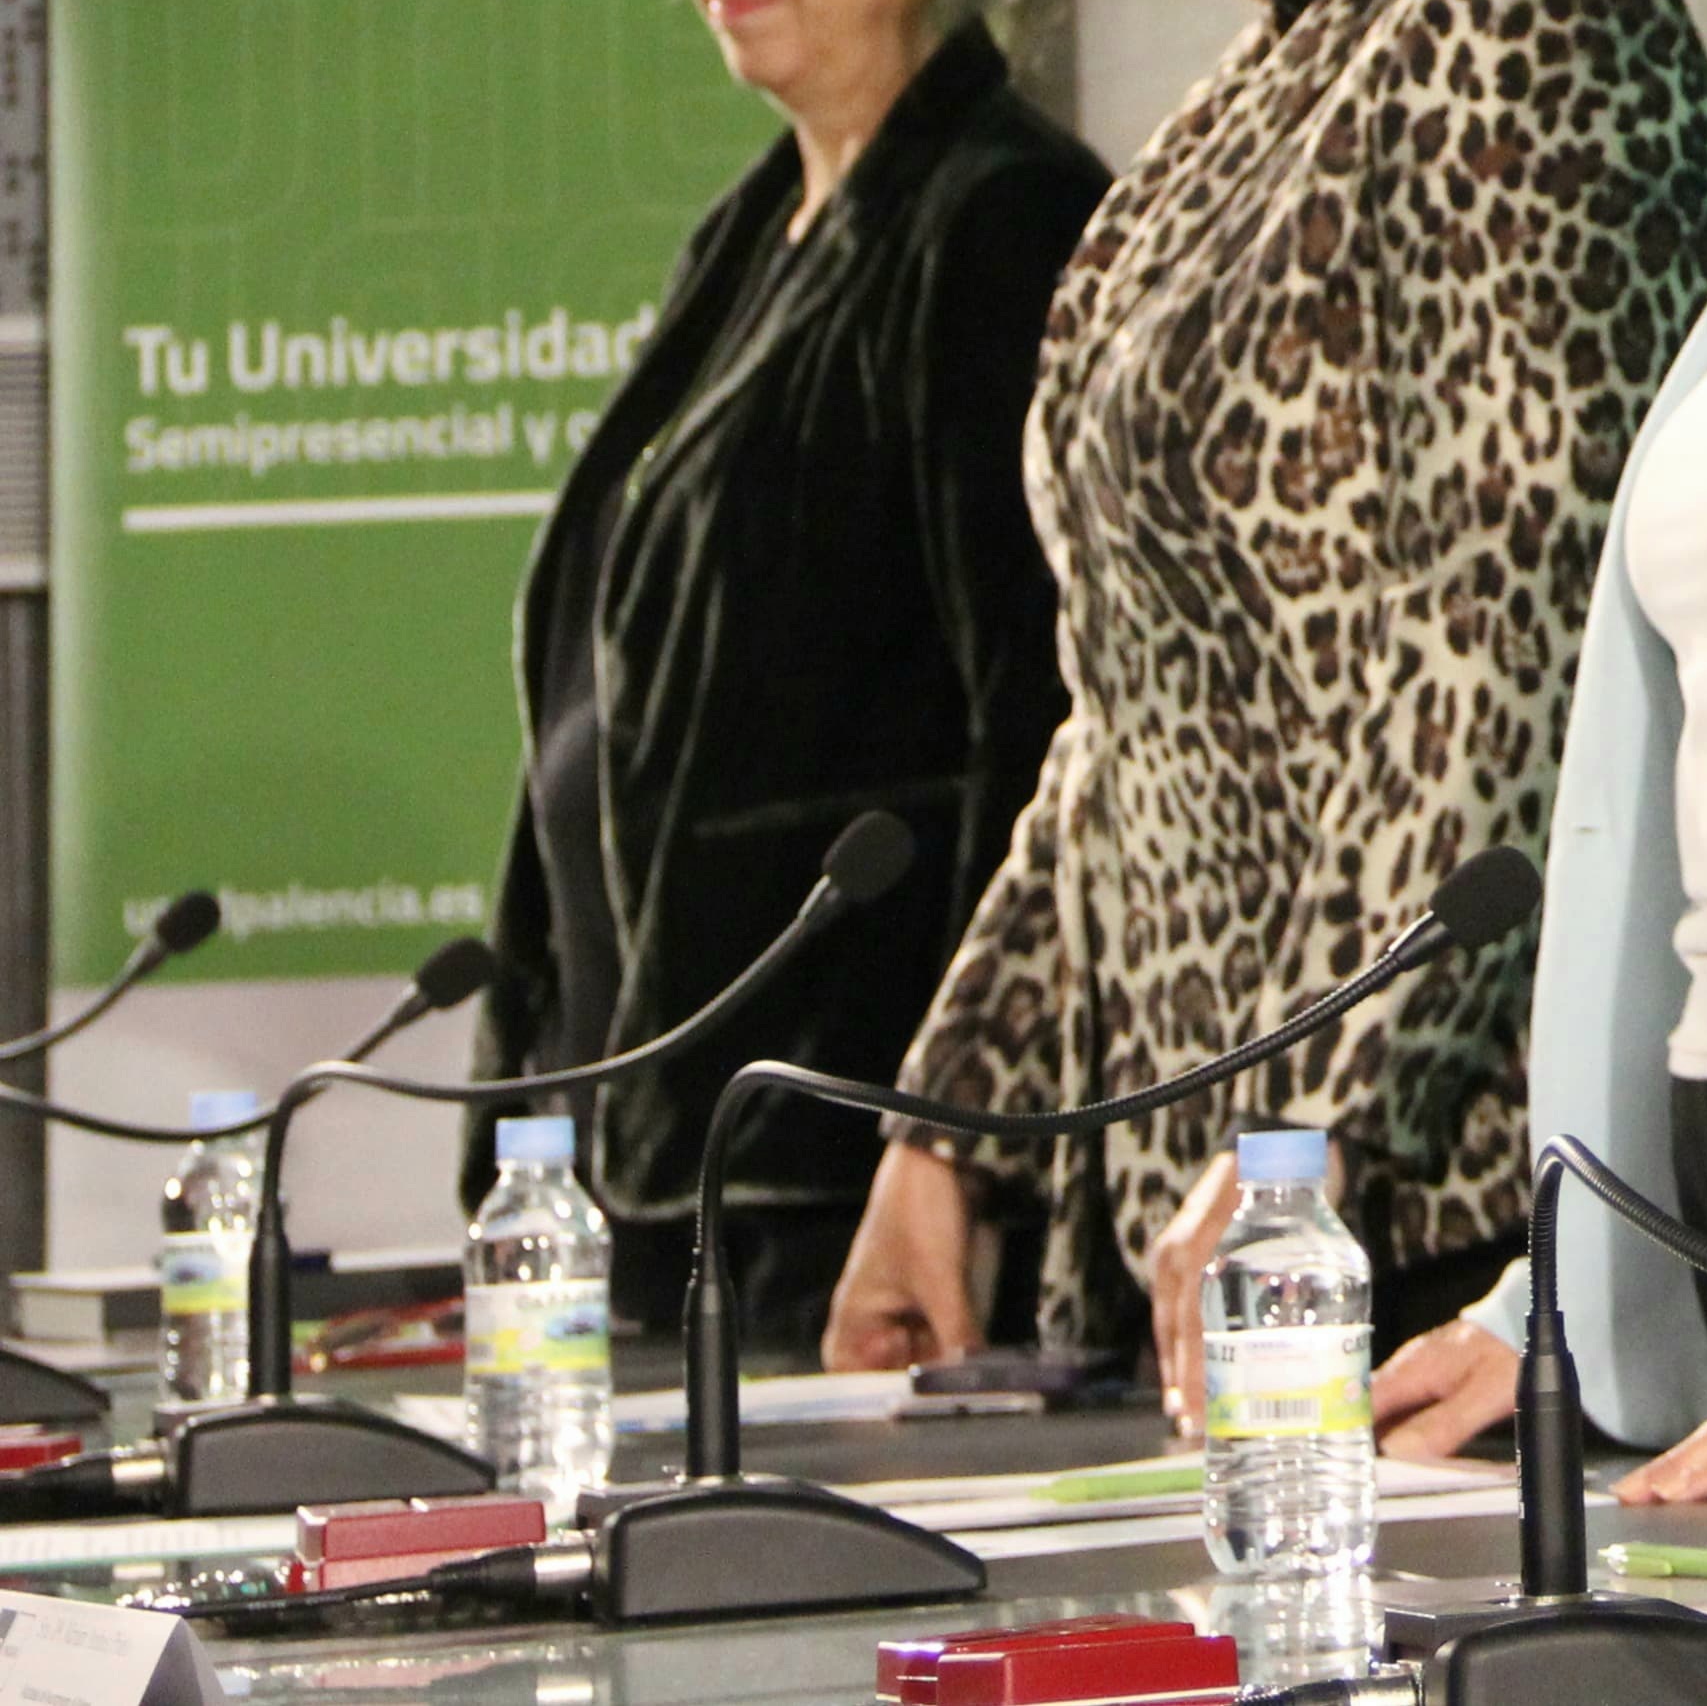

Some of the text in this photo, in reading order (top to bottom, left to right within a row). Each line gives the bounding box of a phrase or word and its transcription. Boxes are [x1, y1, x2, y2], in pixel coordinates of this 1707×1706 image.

[123, 304, 657, 395] Tu Universidad
[124, 406, 510, 474] Semipresencial
[523, 410, 556, 466] y
